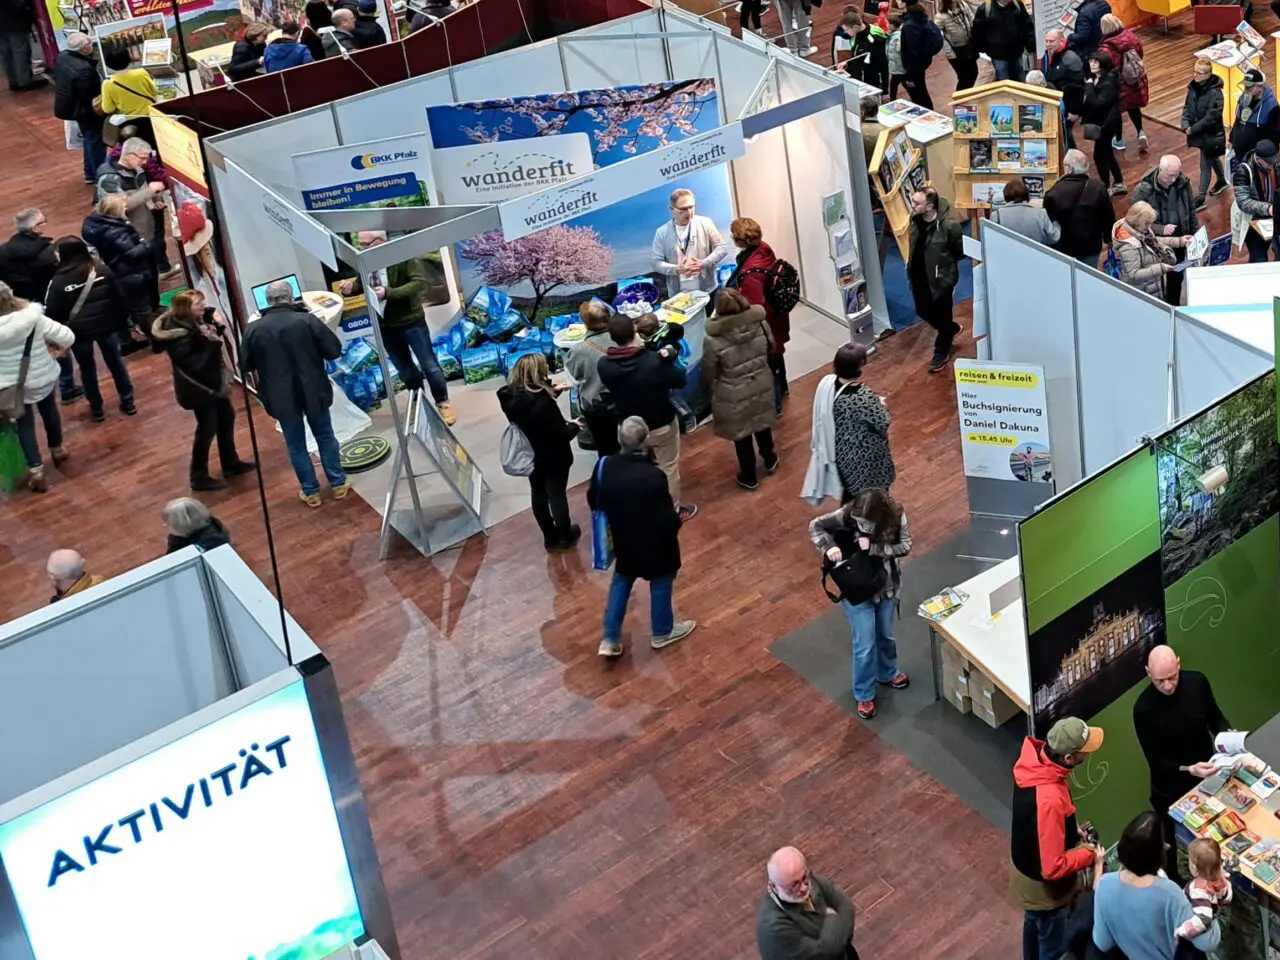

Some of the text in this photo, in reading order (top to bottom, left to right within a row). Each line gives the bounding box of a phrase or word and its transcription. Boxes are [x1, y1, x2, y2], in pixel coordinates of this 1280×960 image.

[371, 150, 418, 164] BKK Pfalz
[660, 144, 726, 177] wanderfit
[461, 160, 576, 189] wanderfit
[310, 176, 407, 200] Immer in Bewegung
[492, 182, 522, 192] Initiative
[312, 195, 351, 209] bleiben!
[524, 191, 599, 227] wanderfit
[348, 318, 369, 329] 0800
[959, 371, 988, 379] reisen
[998, 373, 1032, 382] freizeit
[962, 401, 1042, 417] Buchsignierung
[964, 419, 1039, 432] Daniel Dakuna
[1200, 426, 1228, 446] Wandern
[47, 735, 291, 888] AKTIVITÄT
